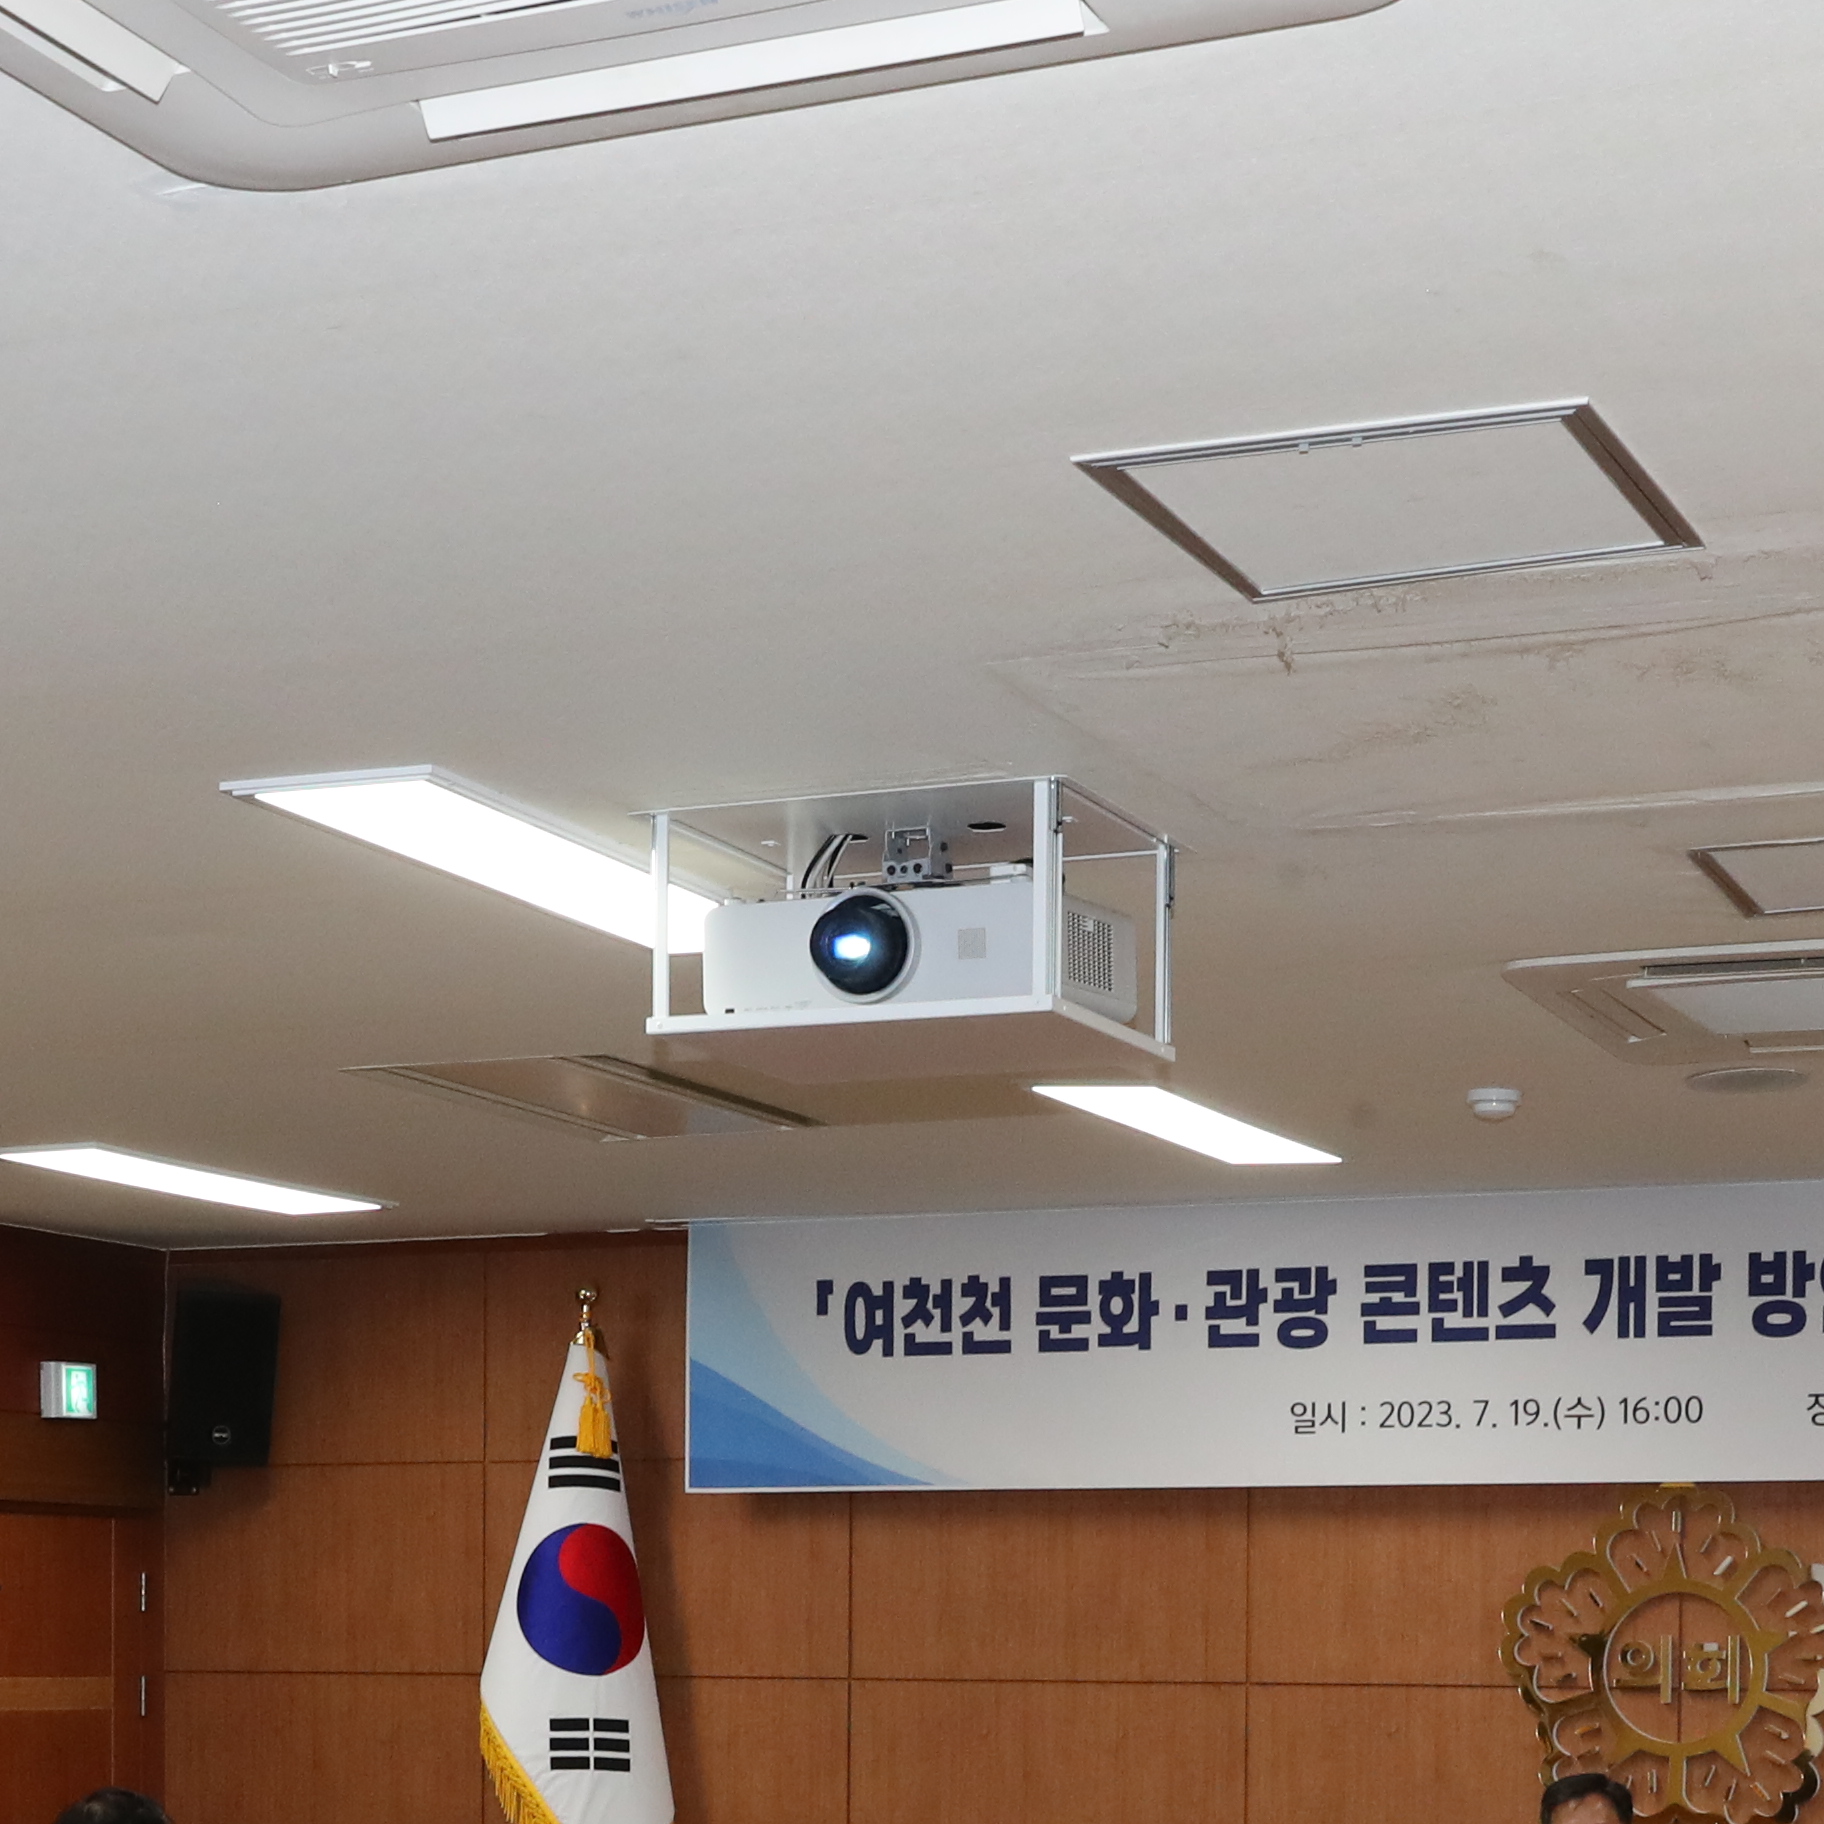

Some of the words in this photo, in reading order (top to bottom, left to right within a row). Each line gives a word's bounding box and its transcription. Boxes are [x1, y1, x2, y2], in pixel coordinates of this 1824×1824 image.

[816, 1274, 1012, 1358] 「여천천
[1360, 1255, 1557, 1345] 콘텐츠
[1581, 1253, 1722, 1340] 개발
[1290, 1400, 1346, 1435] 일시
[1379, 1400, 1461, 1429] 2023.
[1473, 1399, 1497, 1429] 7.
[1509, 1396, 1606, 1431] 19.(수)
[1618, 1395, 1704, 1425] 16:00
[1612, 1633, 1744, 1706] 의회
